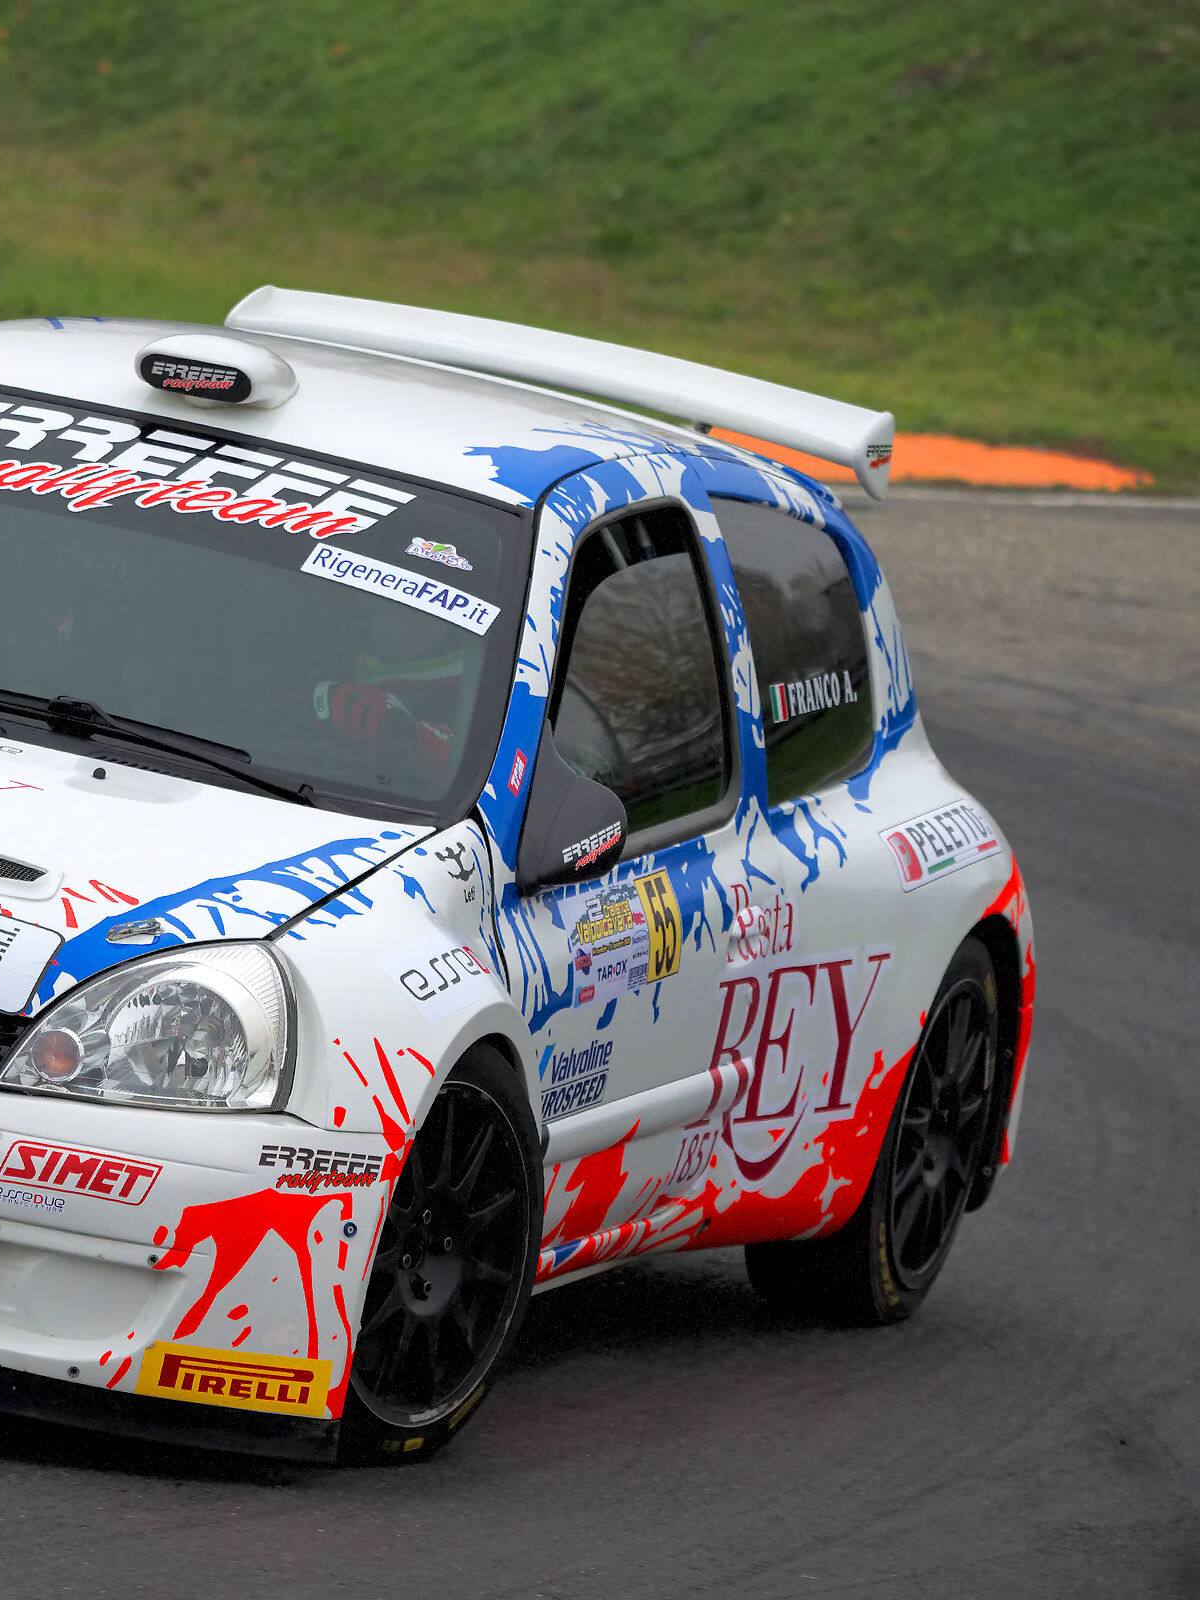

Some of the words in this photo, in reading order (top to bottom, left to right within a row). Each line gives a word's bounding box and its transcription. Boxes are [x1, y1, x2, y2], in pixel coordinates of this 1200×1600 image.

[152, 361, 238, 386] ERREFFE
[162, 377, 233, 391] rallyteam
[313, 546, 490, 626] RigeneraFAP.it
[787, 672, 841, 717] FRANCO
[843, 670, 858, 704] A.
[562, 821, 621, 864] ERREFFE
[905, 805, 988, 862] PELETTO
[643, 877, 676, 977] 55
[728, 884, 794, 963] Pasta
[551, 1039, 614, 1084] Valvoline
[685, 952, 891, 1182] REY
[3, 1143, 154, 1201] SIMET
[259, 1145, 383, 1176] ERREFFE
[275, 1170, 376, 1191] rallyteam
[667, 1132, 719, 1186] 1851
[157, 1353, 315, 1405] PIRELLI
